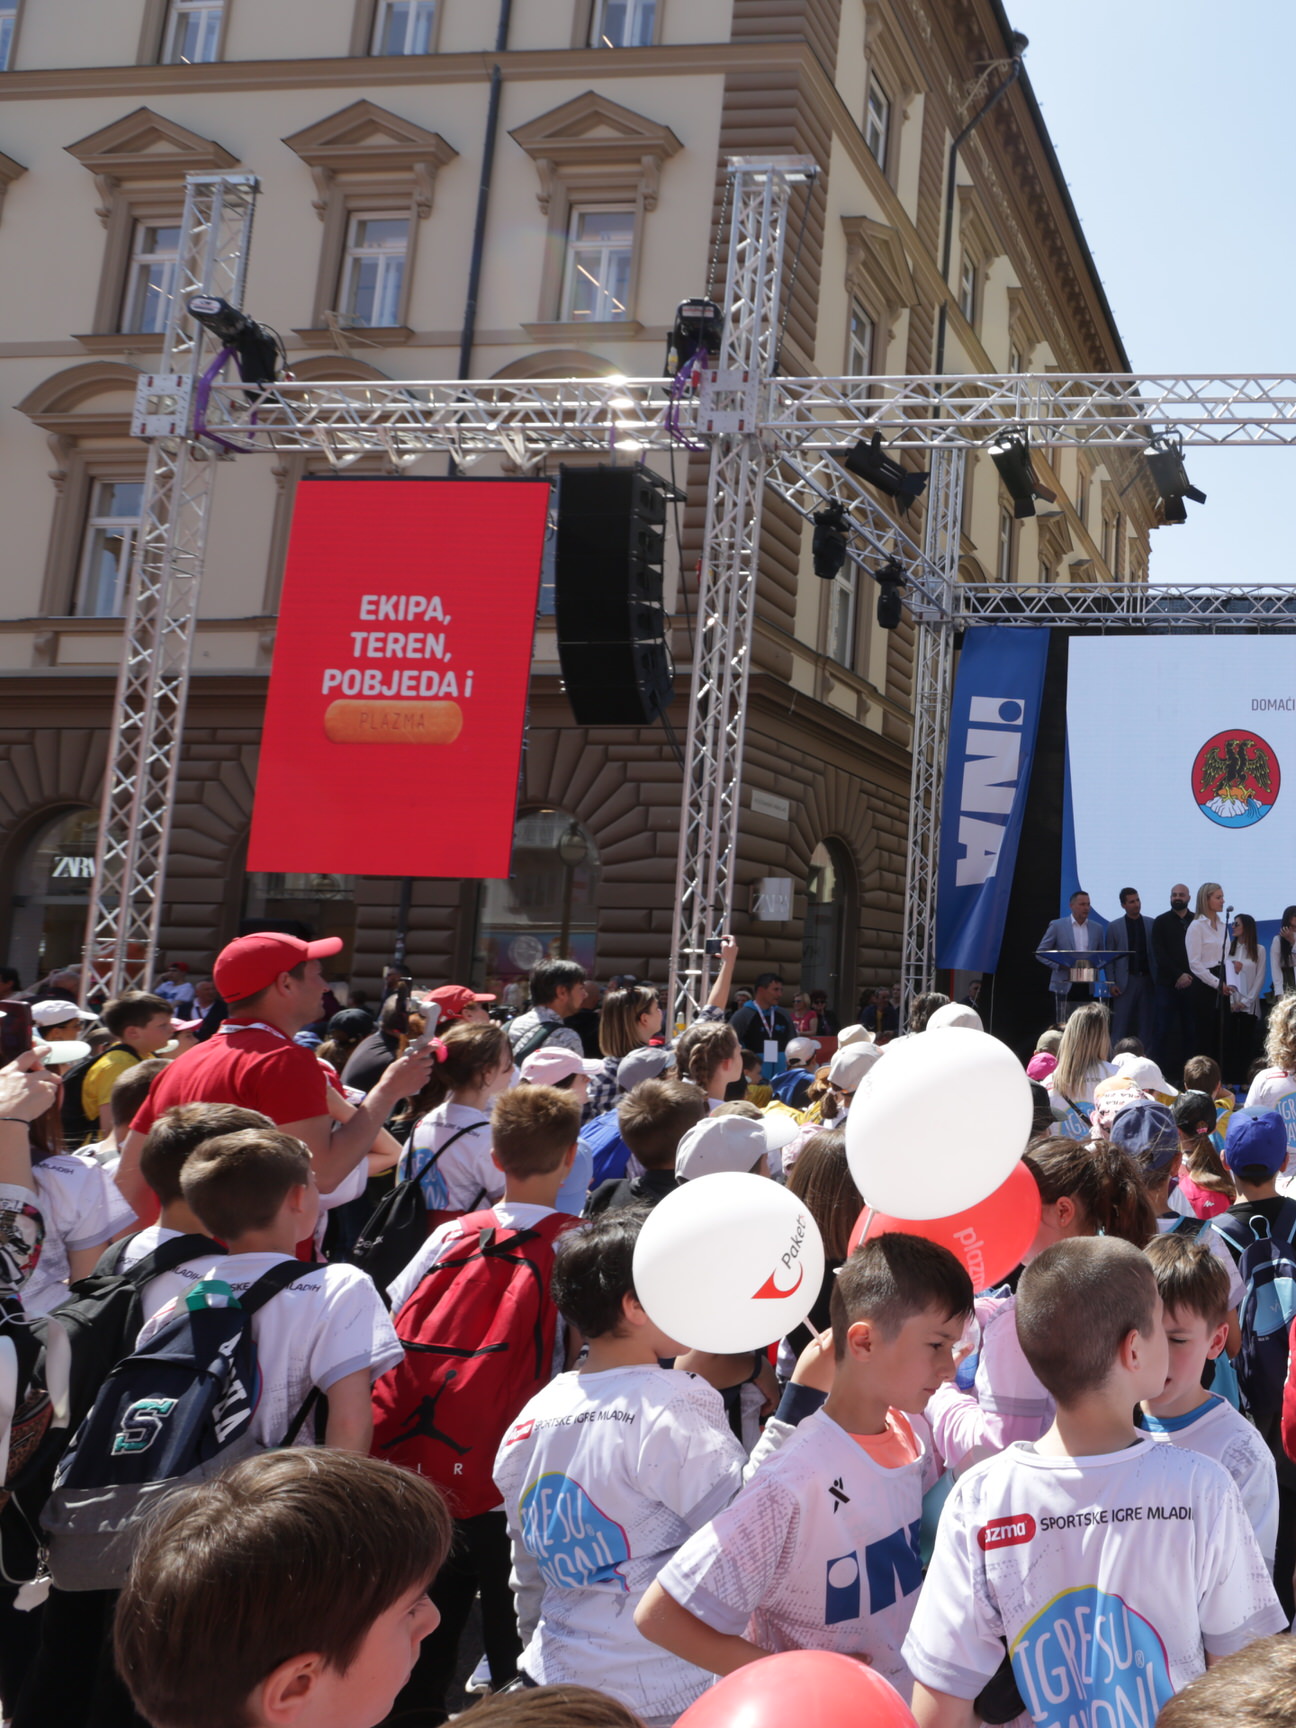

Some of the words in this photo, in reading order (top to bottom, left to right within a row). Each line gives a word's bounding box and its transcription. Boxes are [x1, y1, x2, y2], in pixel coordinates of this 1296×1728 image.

[360, 594, 452, 626] EKIPA,
[350, 631, 452, 663] TEREN,
[321, 668, 459, 697] POBJEDA
[464, 670, 474, 698] i
[359, 712, 425, 730] PLAZMA
[574, 1411, 596, 1424] IGRE
[597, 1409, 635, 1424] MLADIH
[1040, 1510, 1108, 1531] SPORTSKE
[1111, 1507, 1142, 1522] IGRE
[1147, 1506, 1193, 1520] MLADI
[1014, 1606, 1093, 1722] IGRE
